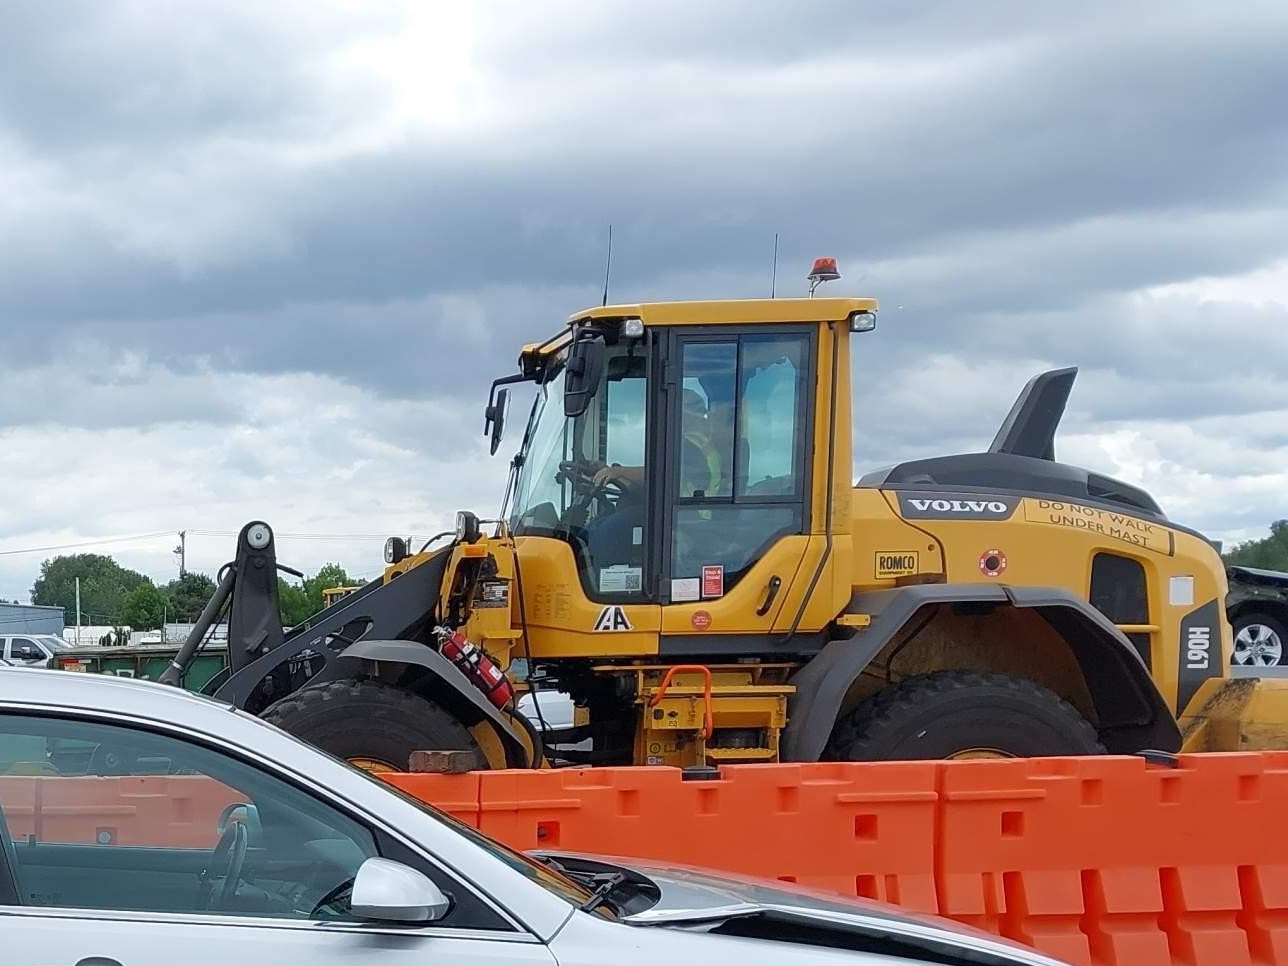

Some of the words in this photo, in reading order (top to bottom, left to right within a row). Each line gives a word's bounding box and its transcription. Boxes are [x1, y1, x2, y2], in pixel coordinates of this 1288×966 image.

[908, 499, 1008, 513] VOLVO
[1039, 501, 1064, 511] DO
[1070, 505, 1105, 519] NOT
[1111, 514, 1154, 534] WALK
[1050, 514, 1104, 533] UNDER
[1110, 527, 1149, 546] MAST
[879, 555, 915, 570] ROMCO
[1186, 626, 1211, 669] L90H
